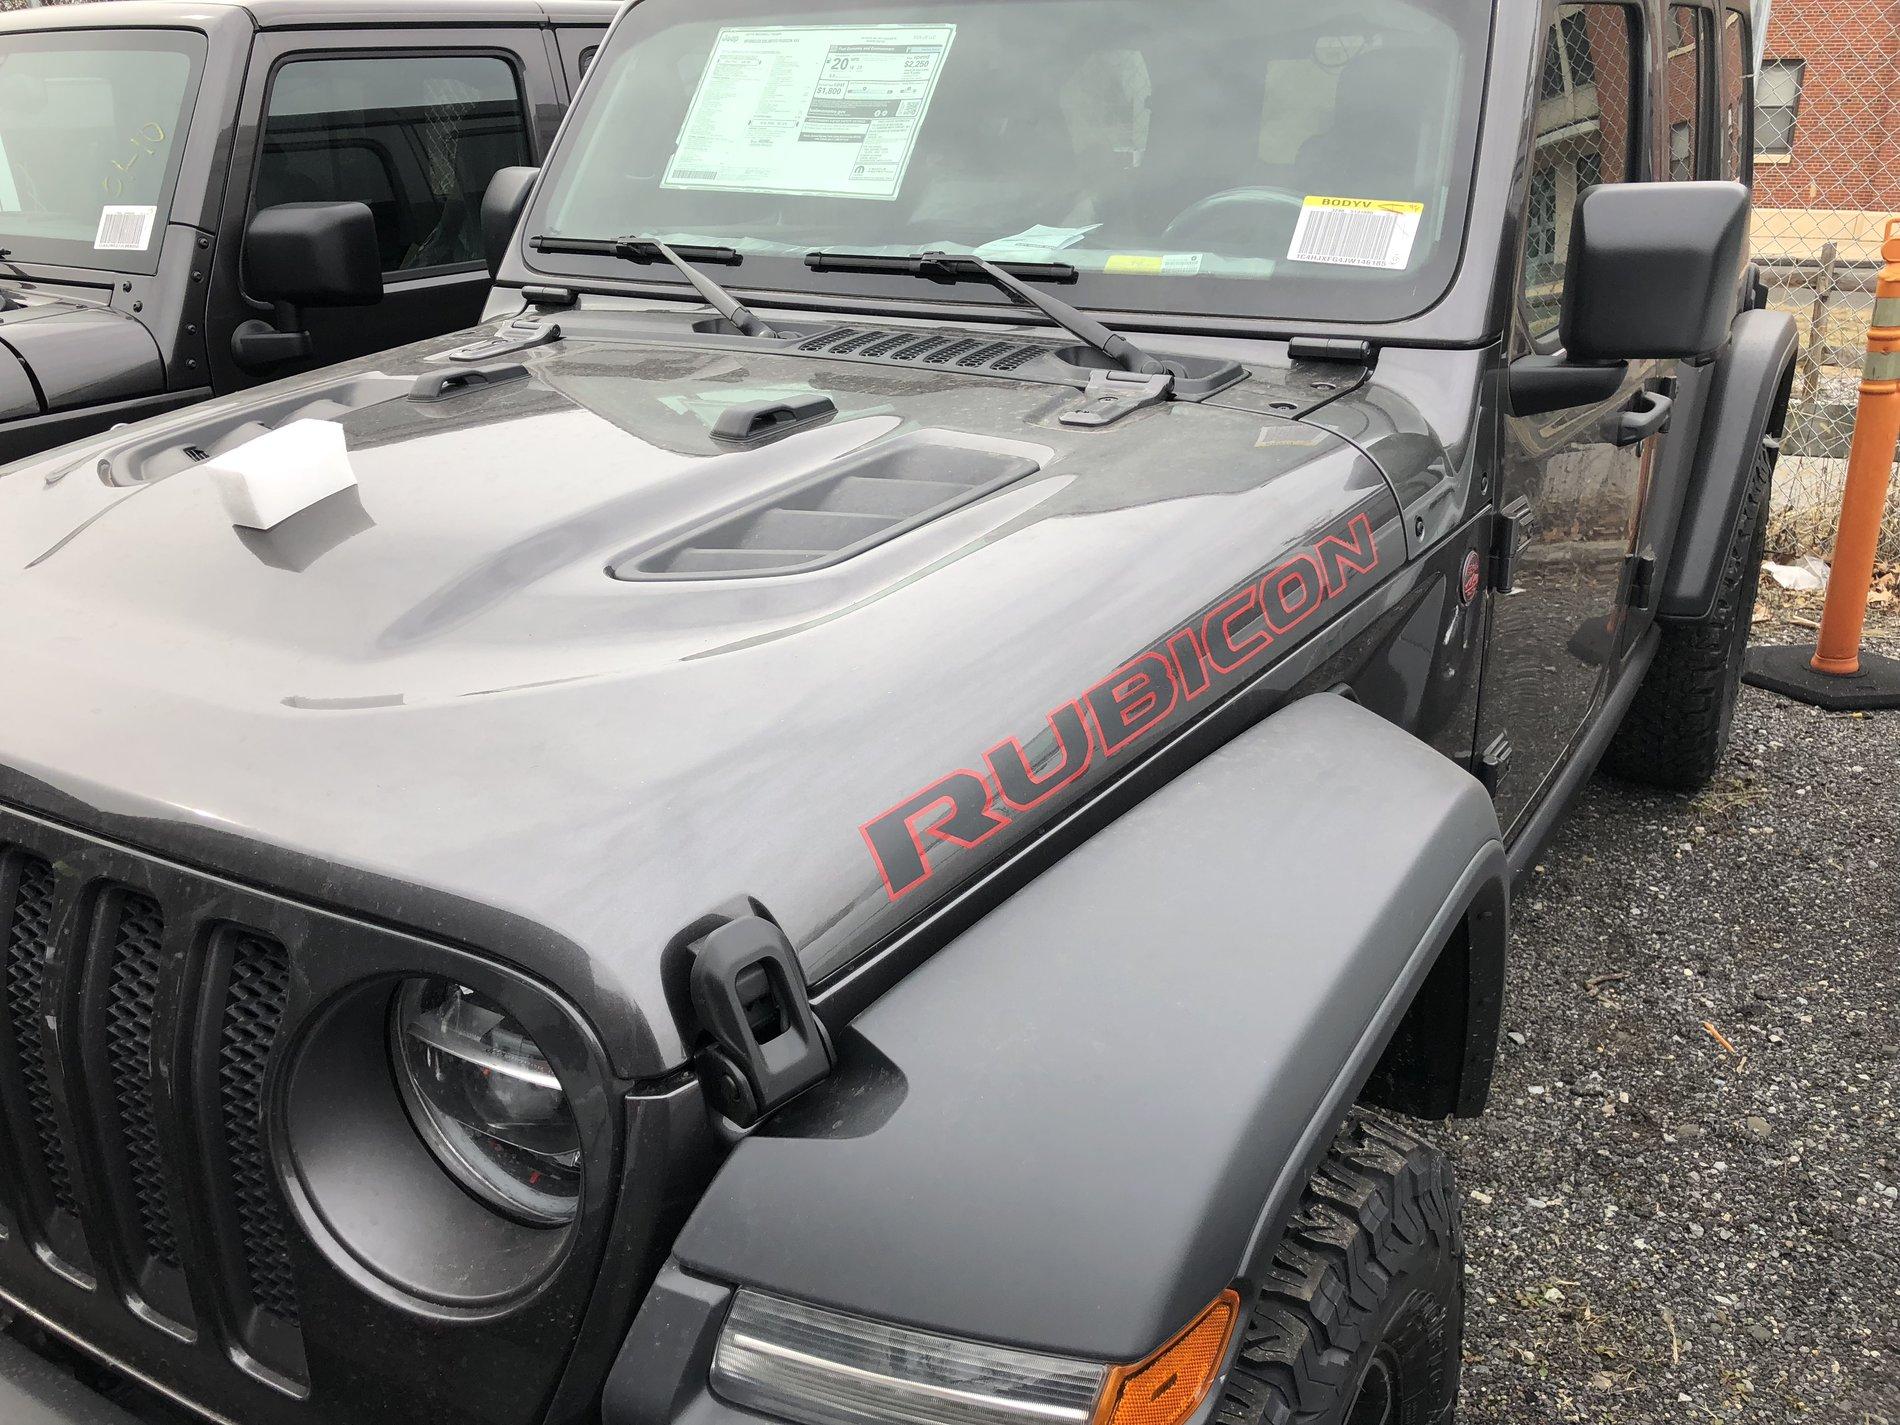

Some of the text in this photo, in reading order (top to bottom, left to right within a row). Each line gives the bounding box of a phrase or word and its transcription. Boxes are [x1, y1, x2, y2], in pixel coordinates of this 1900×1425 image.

[831, 57, 849, 70] 20
[904, 60, 929, 68] $2,250
[817, 87, 841, 95] $1,800
[1321, 198, 1372, 208] BODYV
[858, 513, 1380, 902] RUBICON
